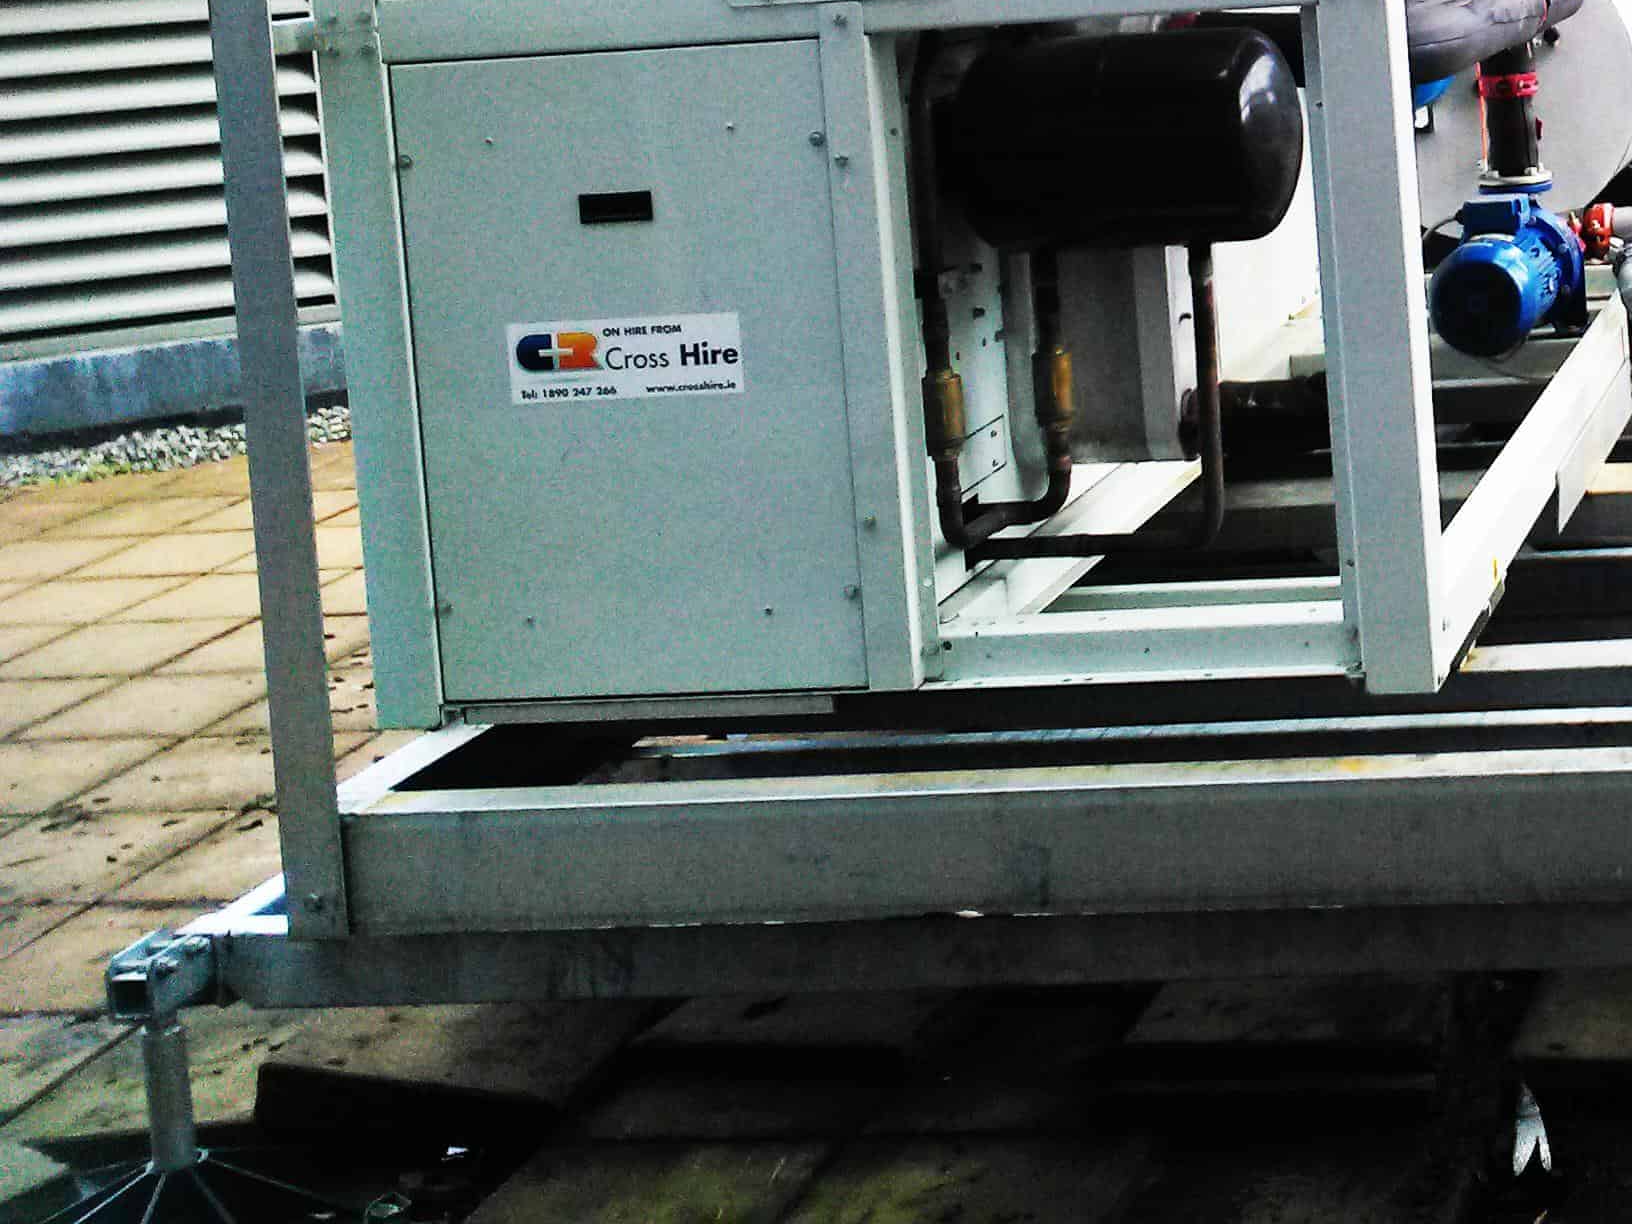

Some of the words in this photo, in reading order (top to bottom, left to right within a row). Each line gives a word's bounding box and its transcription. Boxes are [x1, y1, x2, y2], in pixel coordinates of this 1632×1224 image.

[602, 327, 620, 337] ON
[624, 325, 648, 336] HIRE
[650, 324, 682, 335] FROM
[605, 346, 670, 371] Cross
[679, 341, 739, 367] Hire
[542, 387, 569, 398] 1890
[572, 386, 593, 397] 247
[645, 379, 737, 394] www.crosshire.ie
